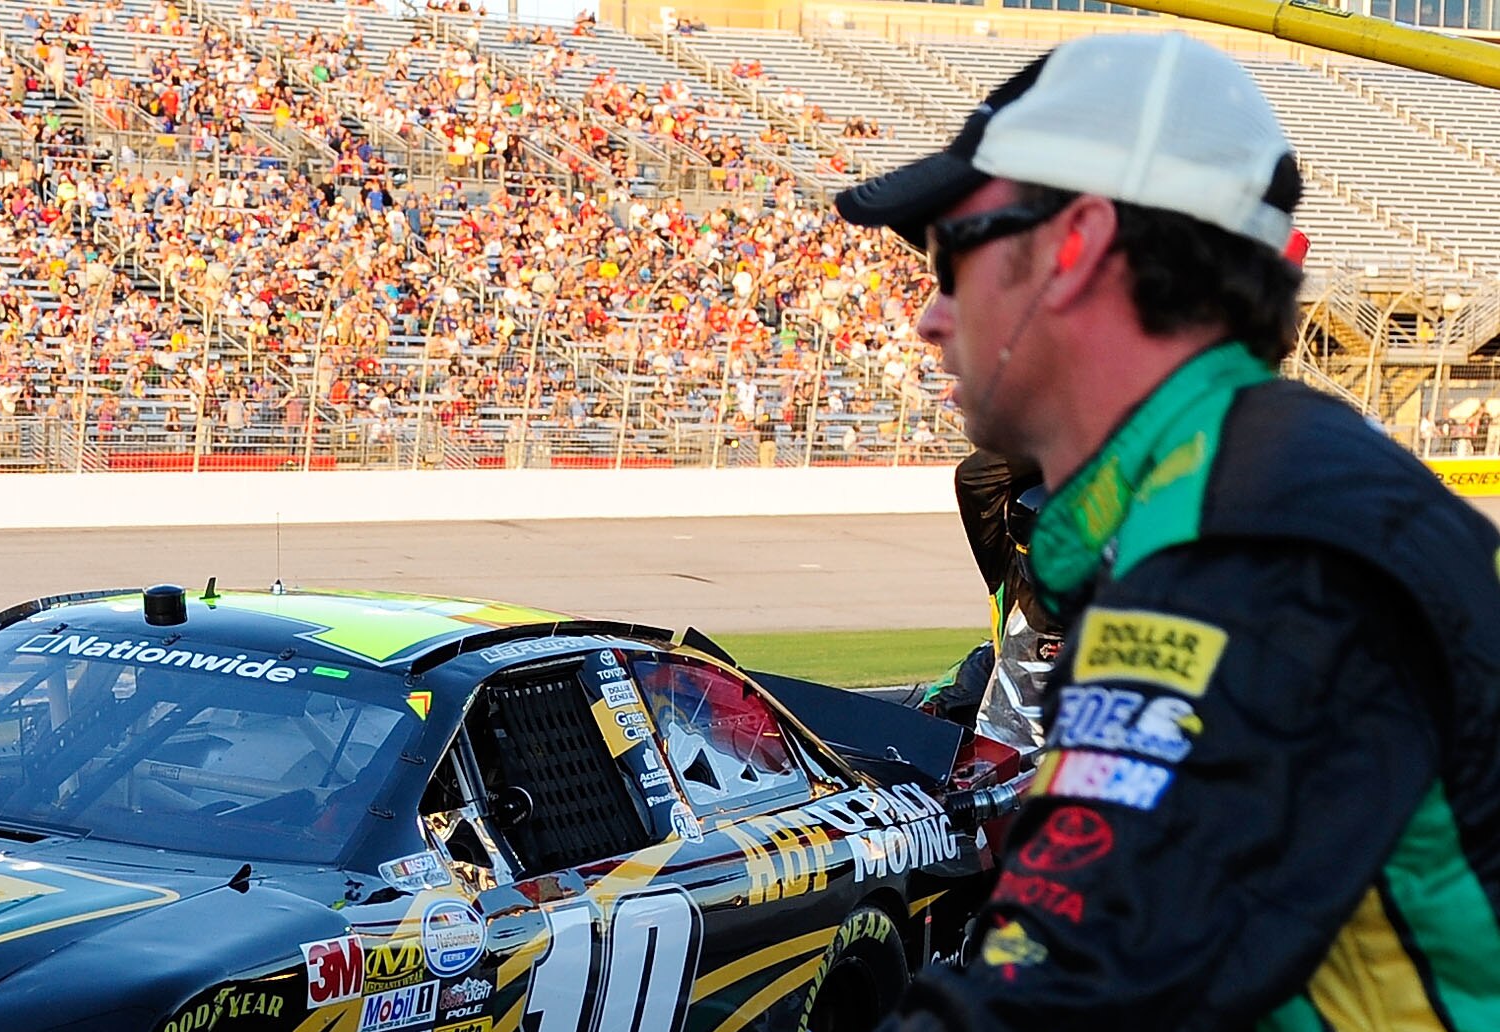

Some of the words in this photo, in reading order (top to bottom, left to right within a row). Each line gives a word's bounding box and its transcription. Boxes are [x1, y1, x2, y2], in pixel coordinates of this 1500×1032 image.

[50, 634, 300, 683] Nationwide
[1100, 622, 1200, 655] DOLLAR
[1087, 647, 1199, 678] GENERAL
[806, 782, 947, 834] U-PACK
[846, 814, 960, 883] MOVING
[309, 938, 362, 1003] 3M
[363, 988, 416, 1028] Mobil
[446, 1003, 484, 1020] POLE
